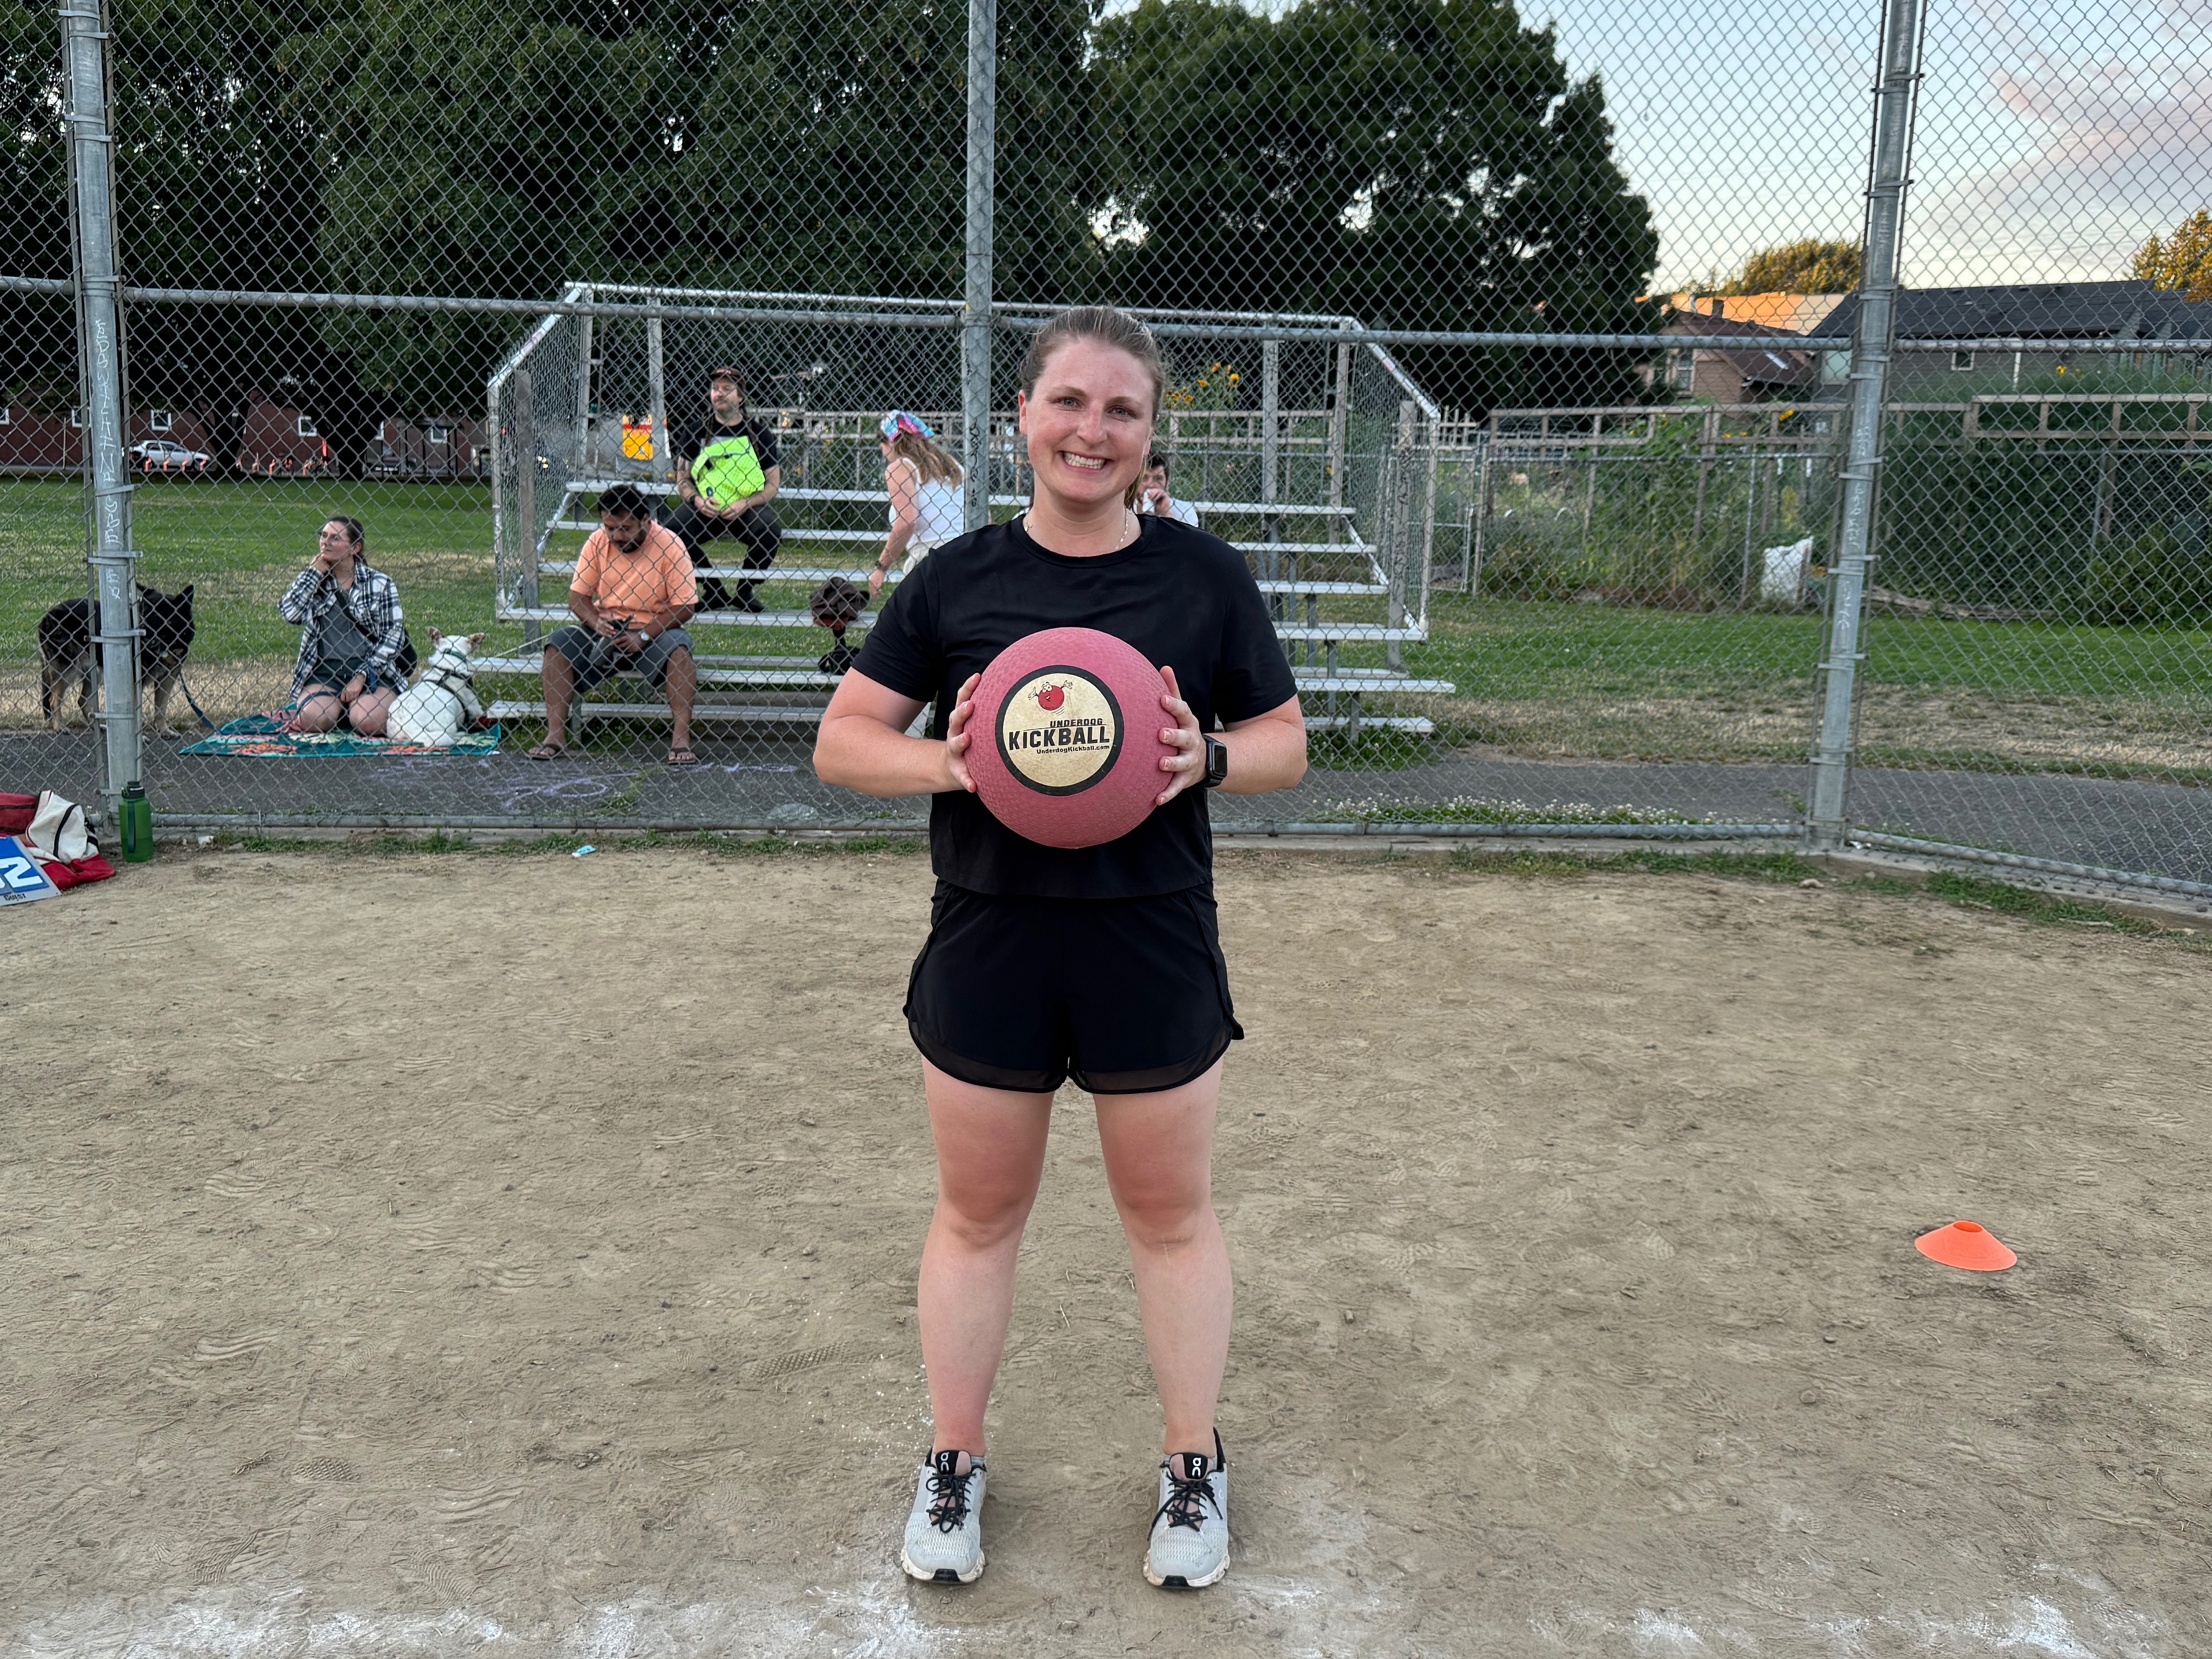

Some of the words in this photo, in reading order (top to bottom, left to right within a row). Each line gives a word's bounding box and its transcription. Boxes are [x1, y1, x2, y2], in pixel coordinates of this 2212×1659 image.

[1049, 718, 1103, 728] UNDERDOG
[1009, 726, 1110, 750] KICKBALL
[1036, 745, 1110, 754] UnderdogKickball.com
[0, 856, 43, 888] 2
